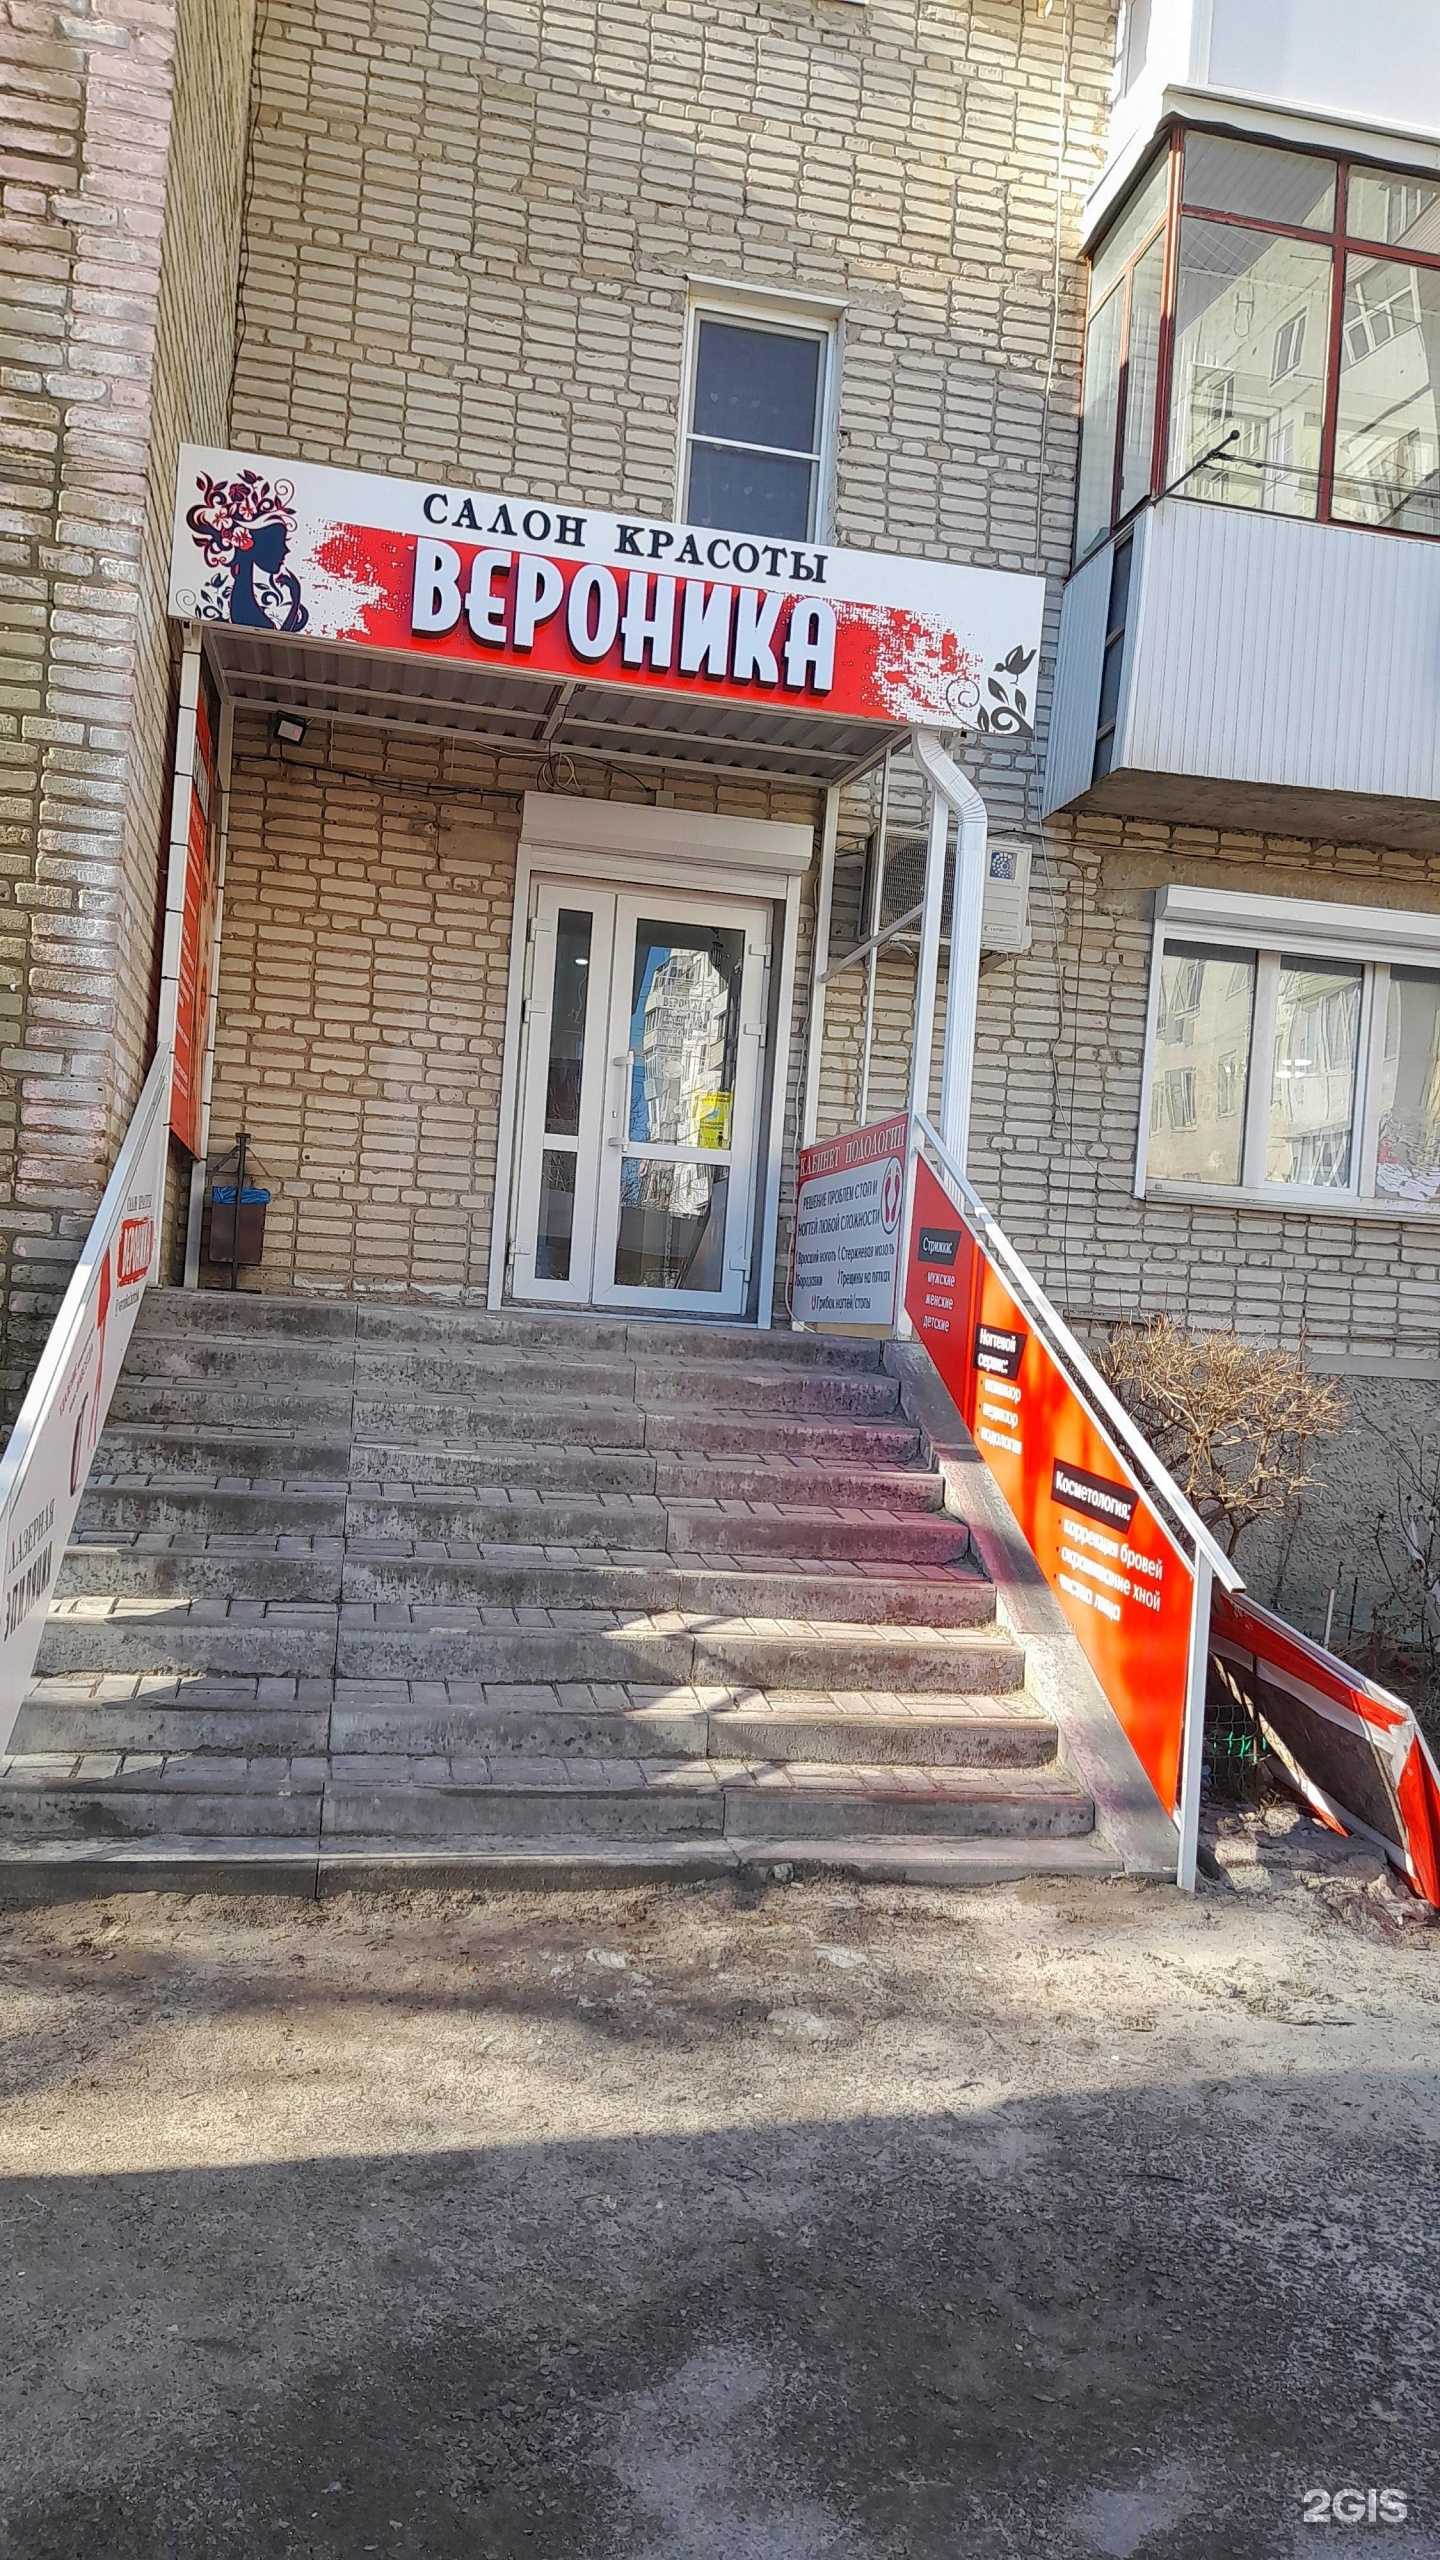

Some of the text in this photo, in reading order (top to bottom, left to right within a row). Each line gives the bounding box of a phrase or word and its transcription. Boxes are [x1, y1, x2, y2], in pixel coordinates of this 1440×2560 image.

[423, 493, 828, 584] САЛОН КРАСОТЫ
[412, 537, 837, 691] ВЕРОНИКА
[800, 1124, 905, 1177] КАБИНЕТ ПОДОЛОГИИ
[803, 1192, 827, 1211] РЕШЕНИЕ
[827, 1186, 854, 1206] ПРОБЛЕМ
[854, 1182, 872, 1199] СТОП
[798, 1209, 880, 1237] НОГТЕЙ ЛЮБОЙ СЛОЖНОСТИ
[841, 1243, 895, 1263] Стержневая мозоль
[927, 1271, 956, 1288] мужские
[816, 1296, 835, 1311] Грибок
[925, 1294, 954, 1310] женские
[922, 1315, 950, 1332] детские
[980, 1328, 1017, 1353] Ногтевой
[1056, 1470, 1131, 1521] Косметология:
[1119, 1542, 1163, 1580] бровей
[1060, 1546, 1131, 1596] окраание
[1132, 1583, 1161, 1613] хной
